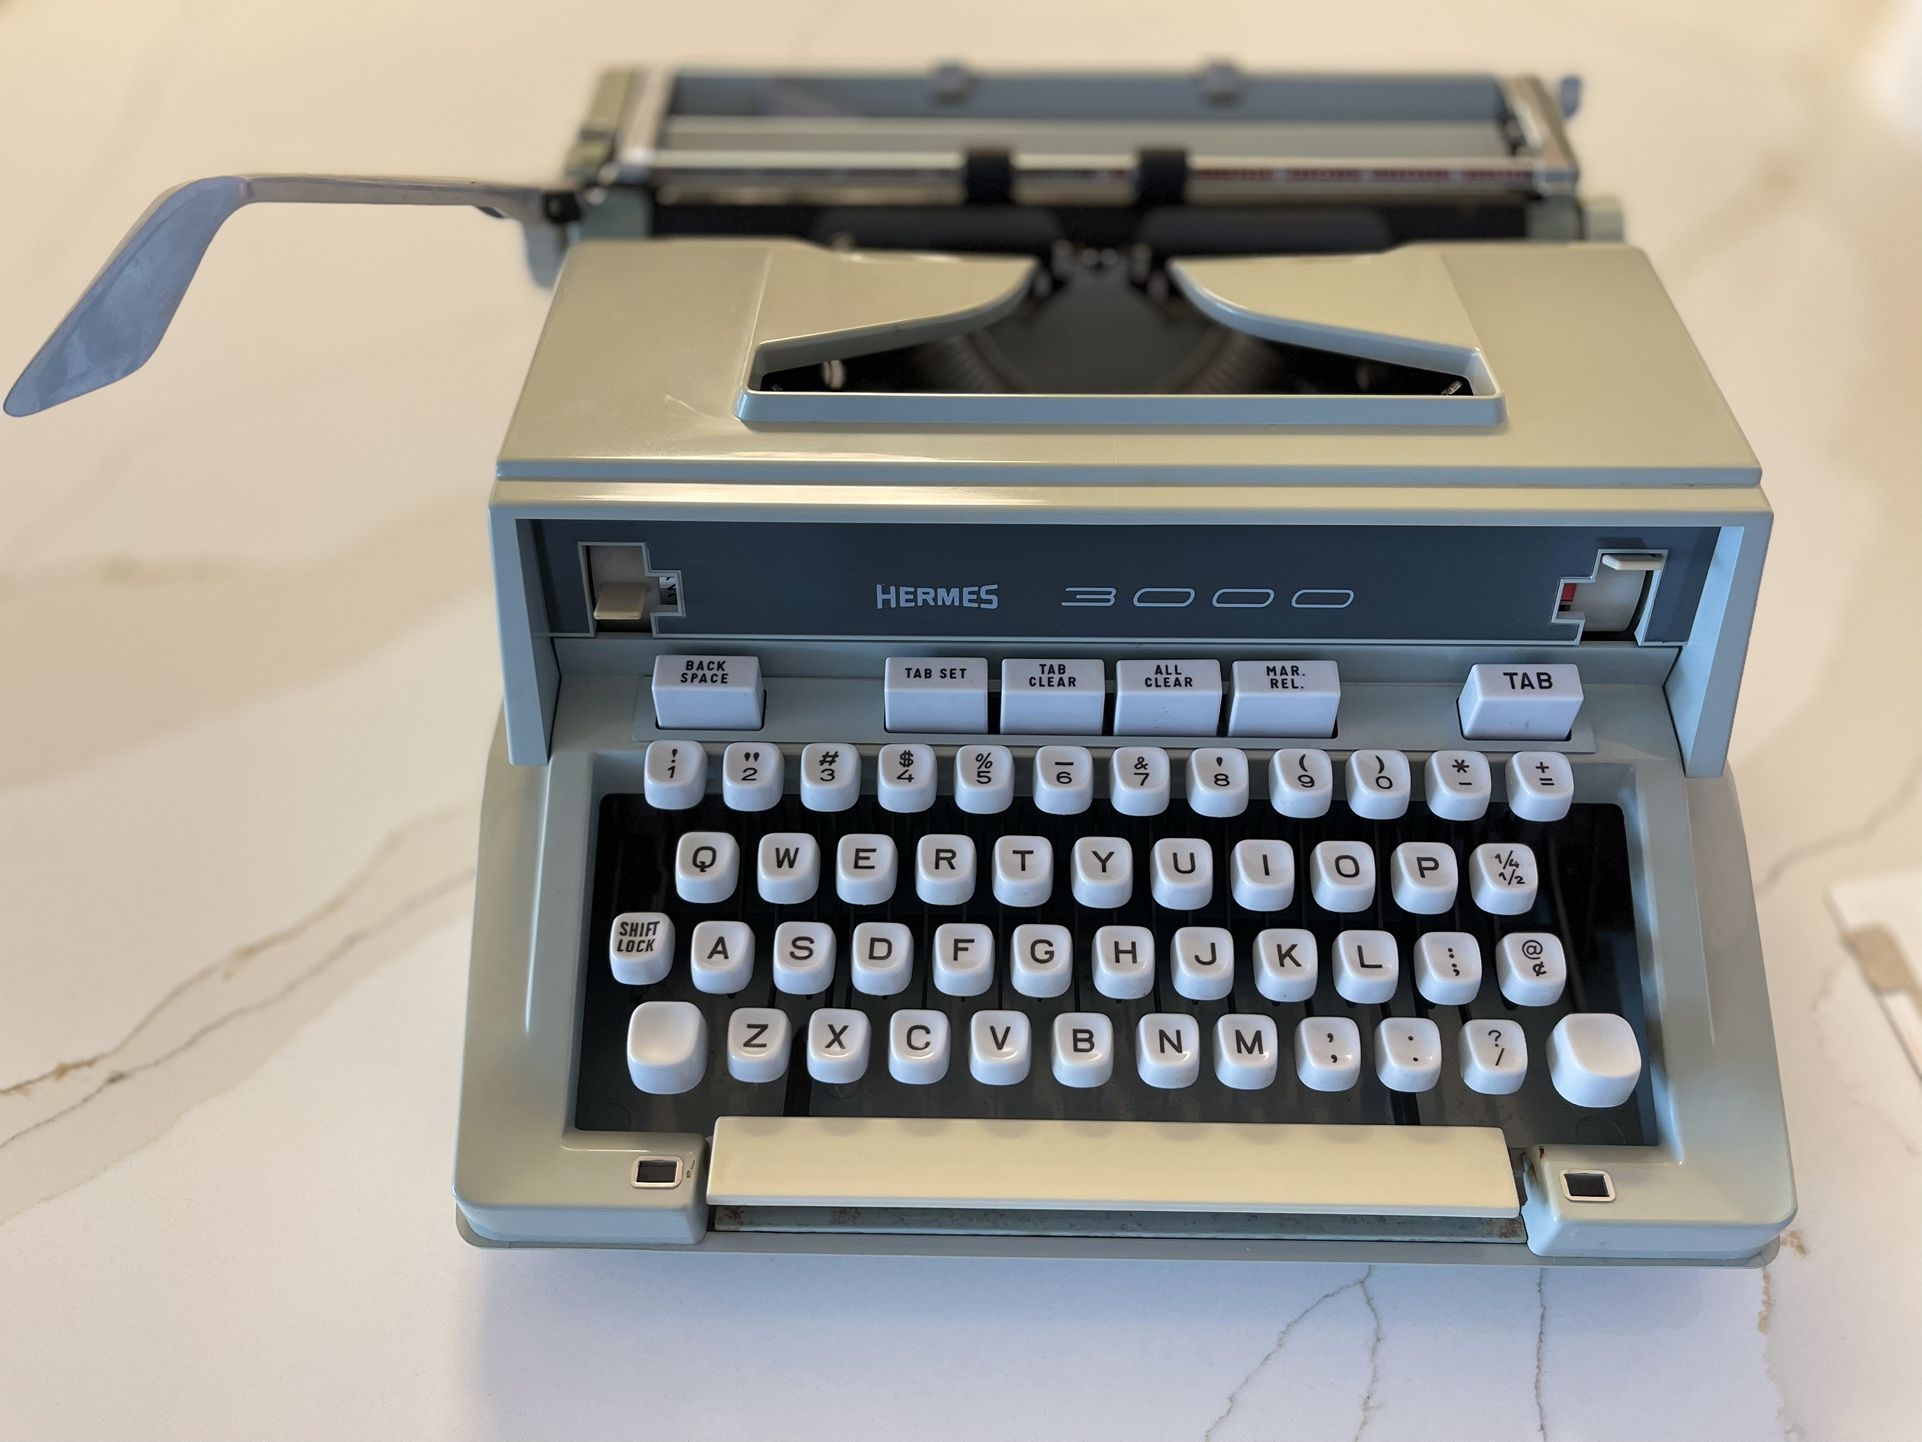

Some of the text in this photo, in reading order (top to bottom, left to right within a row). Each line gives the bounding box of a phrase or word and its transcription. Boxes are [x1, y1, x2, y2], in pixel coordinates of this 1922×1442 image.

[876, 583, 1355, 610] HERMES 3000
[685, 659, 726, 672] BACK
[904, 667, 967, 680] TAB SET
[1039, 663, 1066, 675] TAB
[1154, 664, 1182, 676] ALL
[1266, 665, 1306, 677] MAR.
[680, 672, 729, 684] SPACE
[1028, 676, 1077, 688] CLEAR
[1144, 676, 1193, 688] CLEAR
[1269, 678, 1304, 690] REL.
[1502, 671, 1553, 690] TAB
[670, 748, 678, 764] !
[818, 751, 840, 767] #
[898, 749, 914, 768] $
[975, 752, 993, 770] %
[1133, 756, 1149, 771] &
[1298, 754, 1309, 773] (
[1375, 755, 1385, 775] )
[667, 765, 676, 779] 1
[740, 767, 758, 782] 2
[819, 768, 836, 782] 3
[896, 768, 915, 783] 4
[1535, 761, 1550, 774] +
[975, 770, 992, 785] 5
[1056, 771, 1073, 785] 6
[1133, 772, 1150, 787] 7
[1213, 772, 1231, 787] 8
[1297, 774, 1315, 789] 9
[1539, 777, 1555, 786] =
[692, 845, 717, 873] Q
[775, 847, 800, 869] W
[853, 847, 877, 870] E
[934, 848, 957, 870] R
[1012, 849, 1034, 872] T
[1091, 850, 1115, 873] Y
[1172, 852, 1196, 875] U
[1262, 854, 1270, 877] I
[1334, 854, 1360, 879] O
[1416, 856, 1440, 879] P
[618, 920, 661, 938] SHIFT
[616, 938, 656, 953] LOCK
[706, 936, 729, 960] A
[789, 936, 815, 961] S
[868, 936, 893, 961] D
[952, 938, 975, 962] F
[1030, 938, 1055, 965] G
[1113, 940, 1138, 964] H
[1194, 942, 1217, 966] J
[1521, 939, 1543, 960] @
[1276, 943, 1302, 968] K
[1356, 945, 1383, 969] L
[742, 1023, 769, 1048] Z
[824, 1023, 849, 1050] X
[906, 1024, 931, 1051] C
[989, 1025, 1012, 1051] V
[1072, 1028, 1095, 1053] B
[1158, 1029, 1183, 1054] N
[1234, 1029, 1264, 1055] M
[1487, 1029, 1504, 1046] ?
